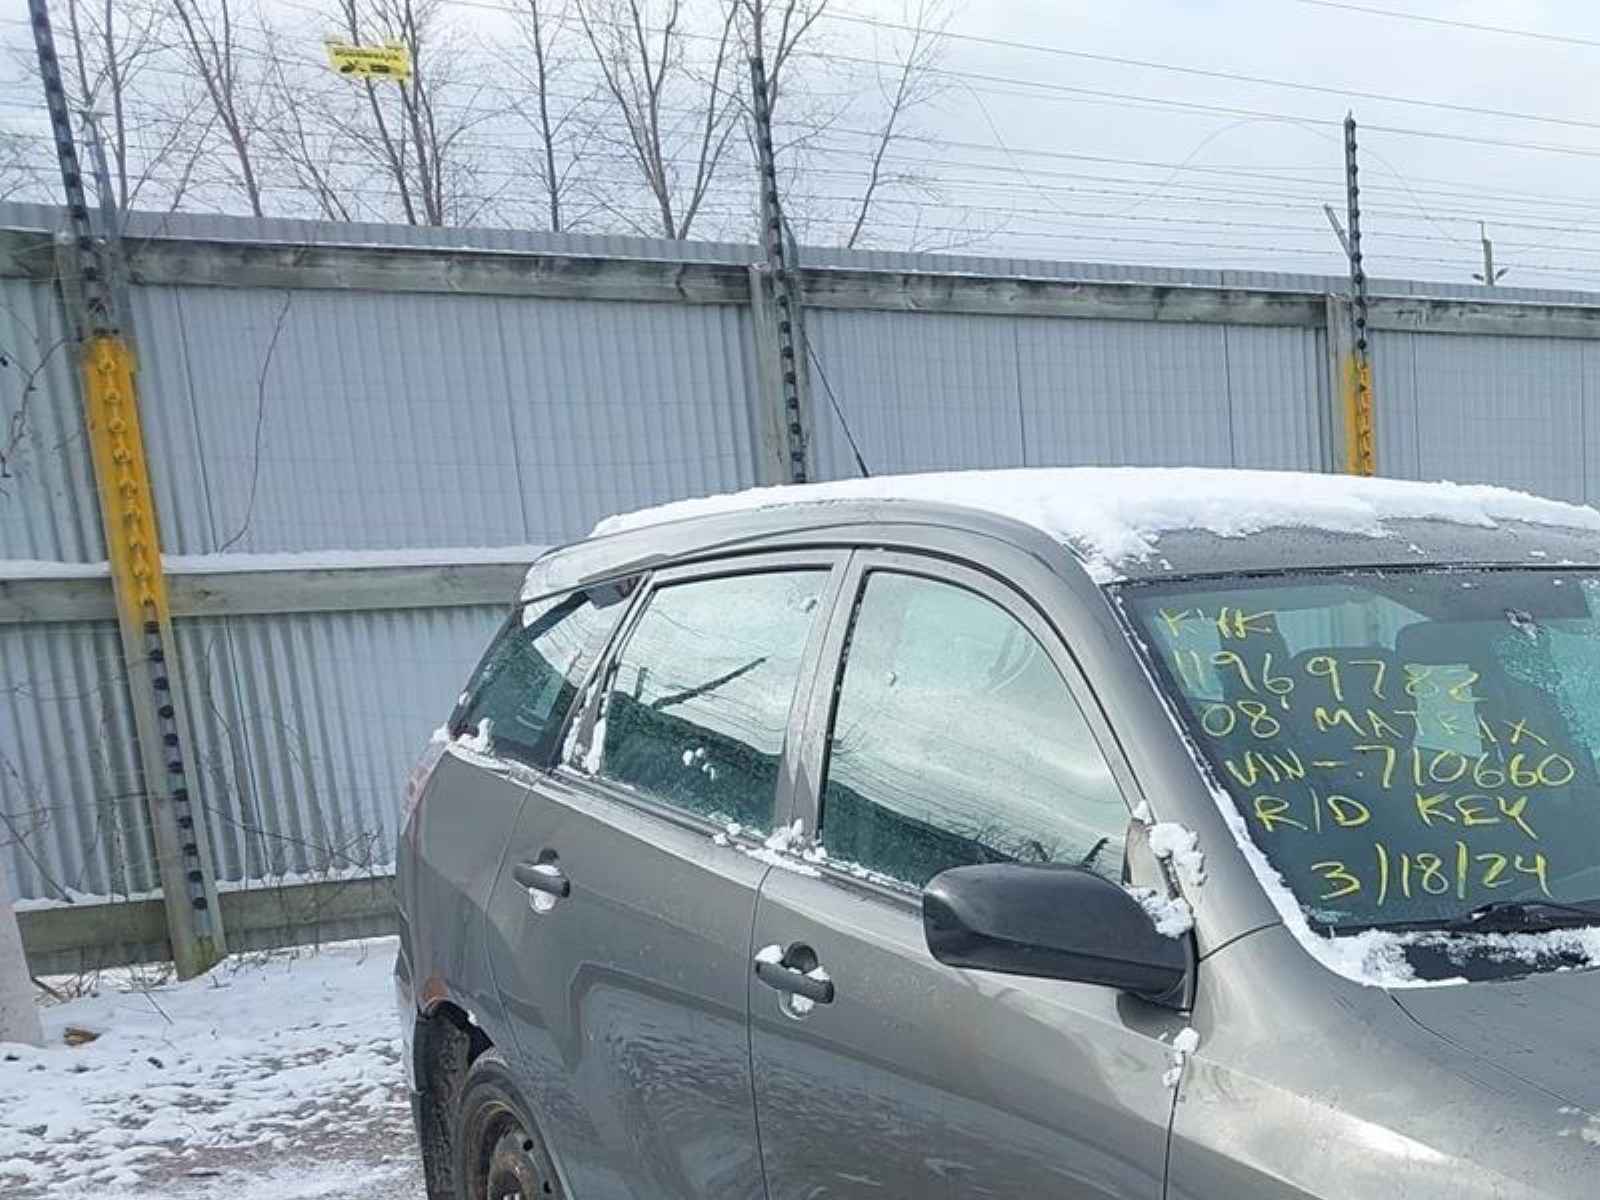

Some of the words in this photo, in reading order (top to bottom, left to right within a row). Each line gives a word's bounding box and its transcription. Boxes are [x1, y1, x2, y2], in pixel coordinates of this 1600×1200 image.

[1172, 650, 1489, 703] 11969782
[1415, 791, 1538, 841] KEY
[1310, 840, 1553, 907] 3/18/24
